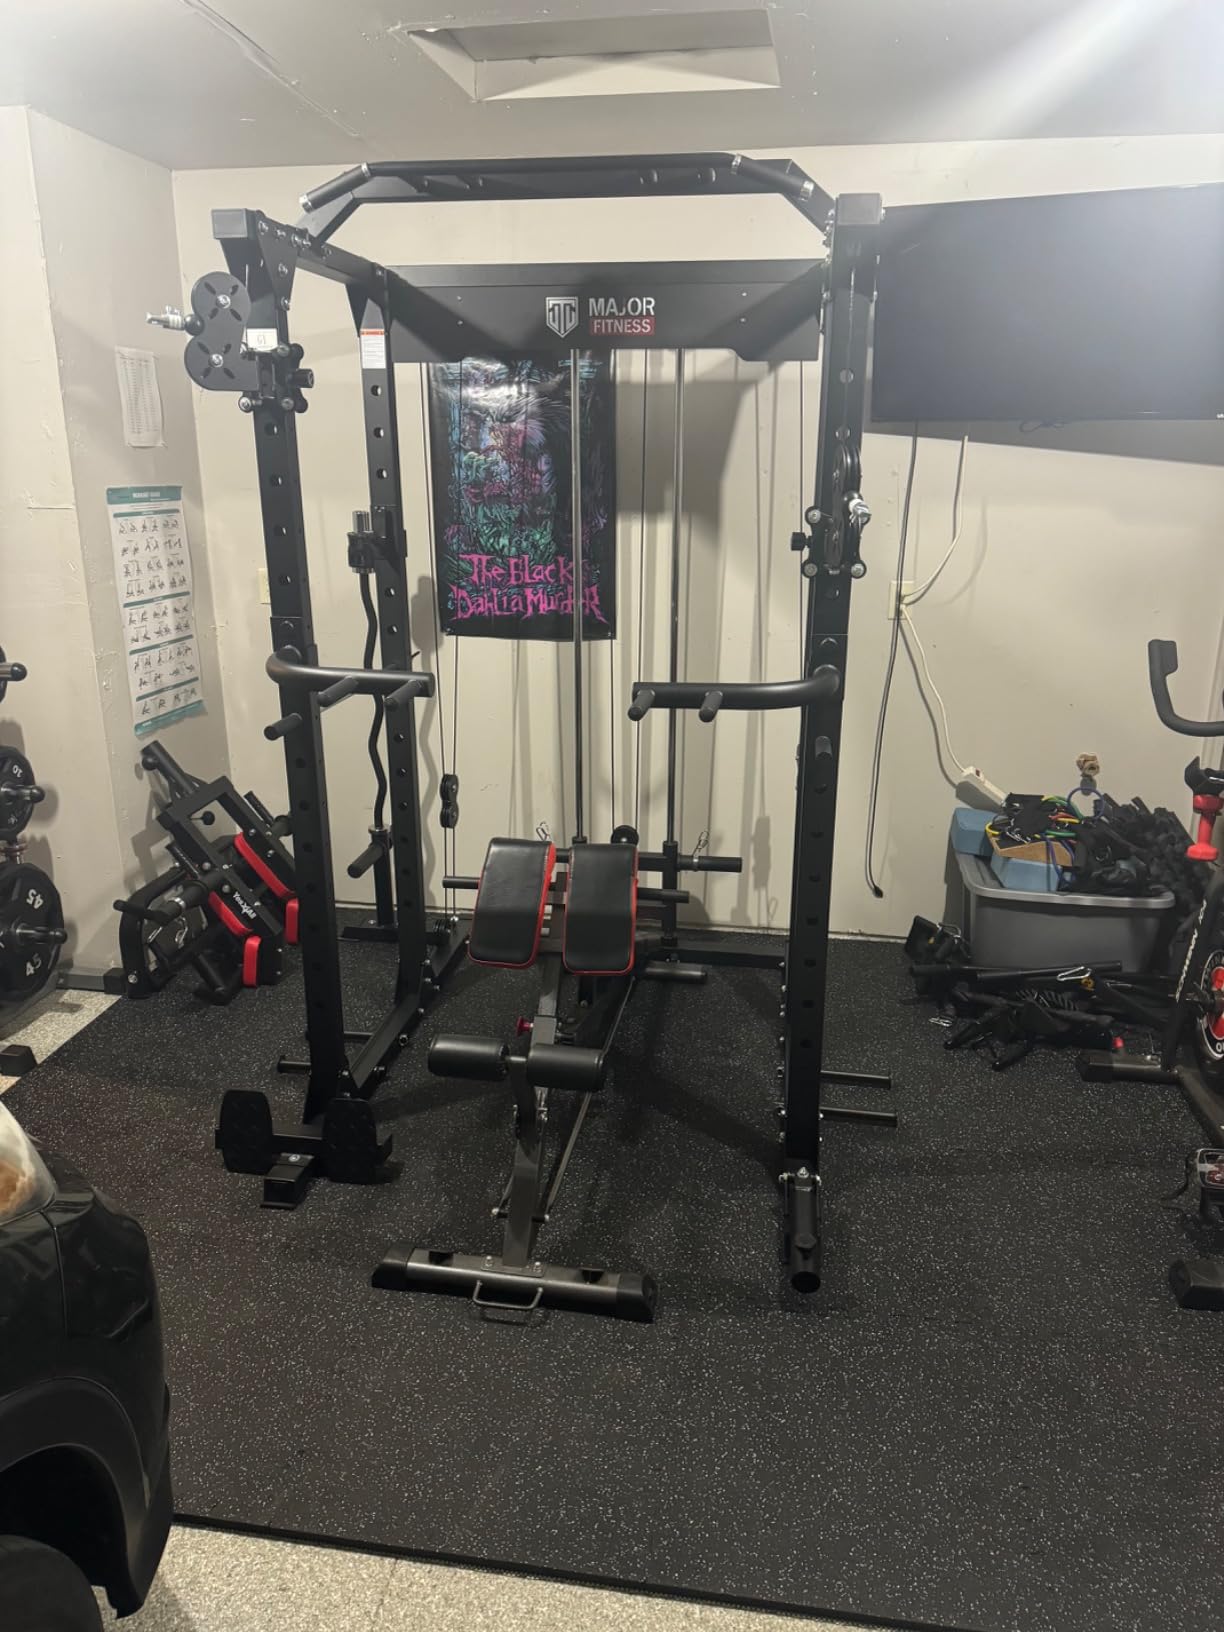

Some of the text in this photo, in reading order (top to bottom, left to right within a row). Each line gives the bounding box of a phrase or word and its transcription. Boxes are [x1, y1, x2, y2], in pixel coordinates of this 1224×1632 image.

[588, 297, 656, 317] MAJOR
[593, 318, 652, 334] FITNESS
[459, 553, 506, 587] The
[26, 888, 44, 909] 45
[26, 952, 42, 977] 45
